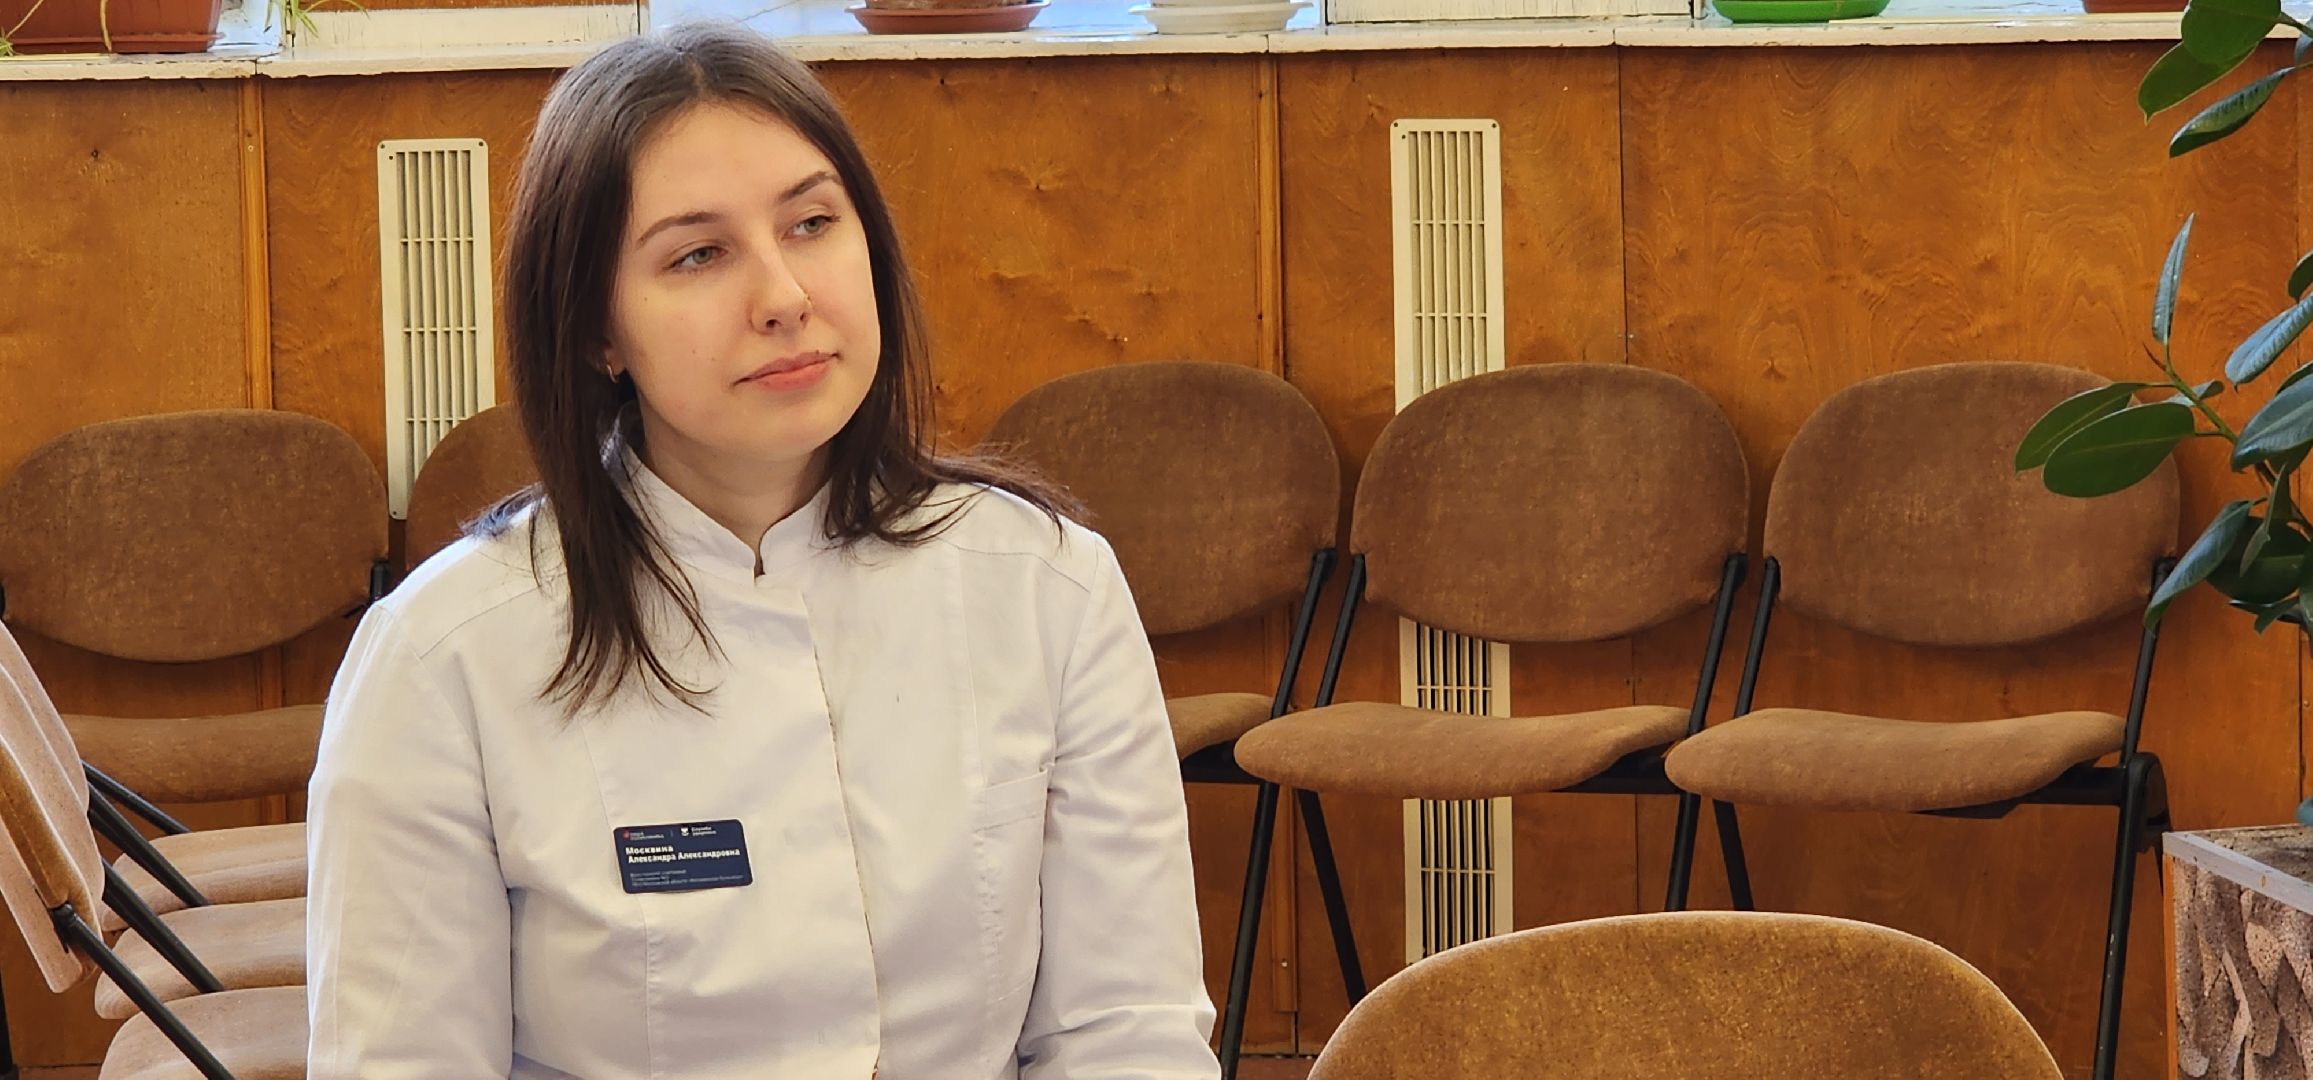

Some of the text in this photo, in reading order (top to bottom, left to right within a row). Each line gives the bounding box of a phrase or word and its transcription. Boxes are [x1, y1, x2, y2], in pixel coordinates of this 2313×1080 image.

[625, 845, 674, 856] Москвина
[628, 848, 741, 864] Александра Александровна
